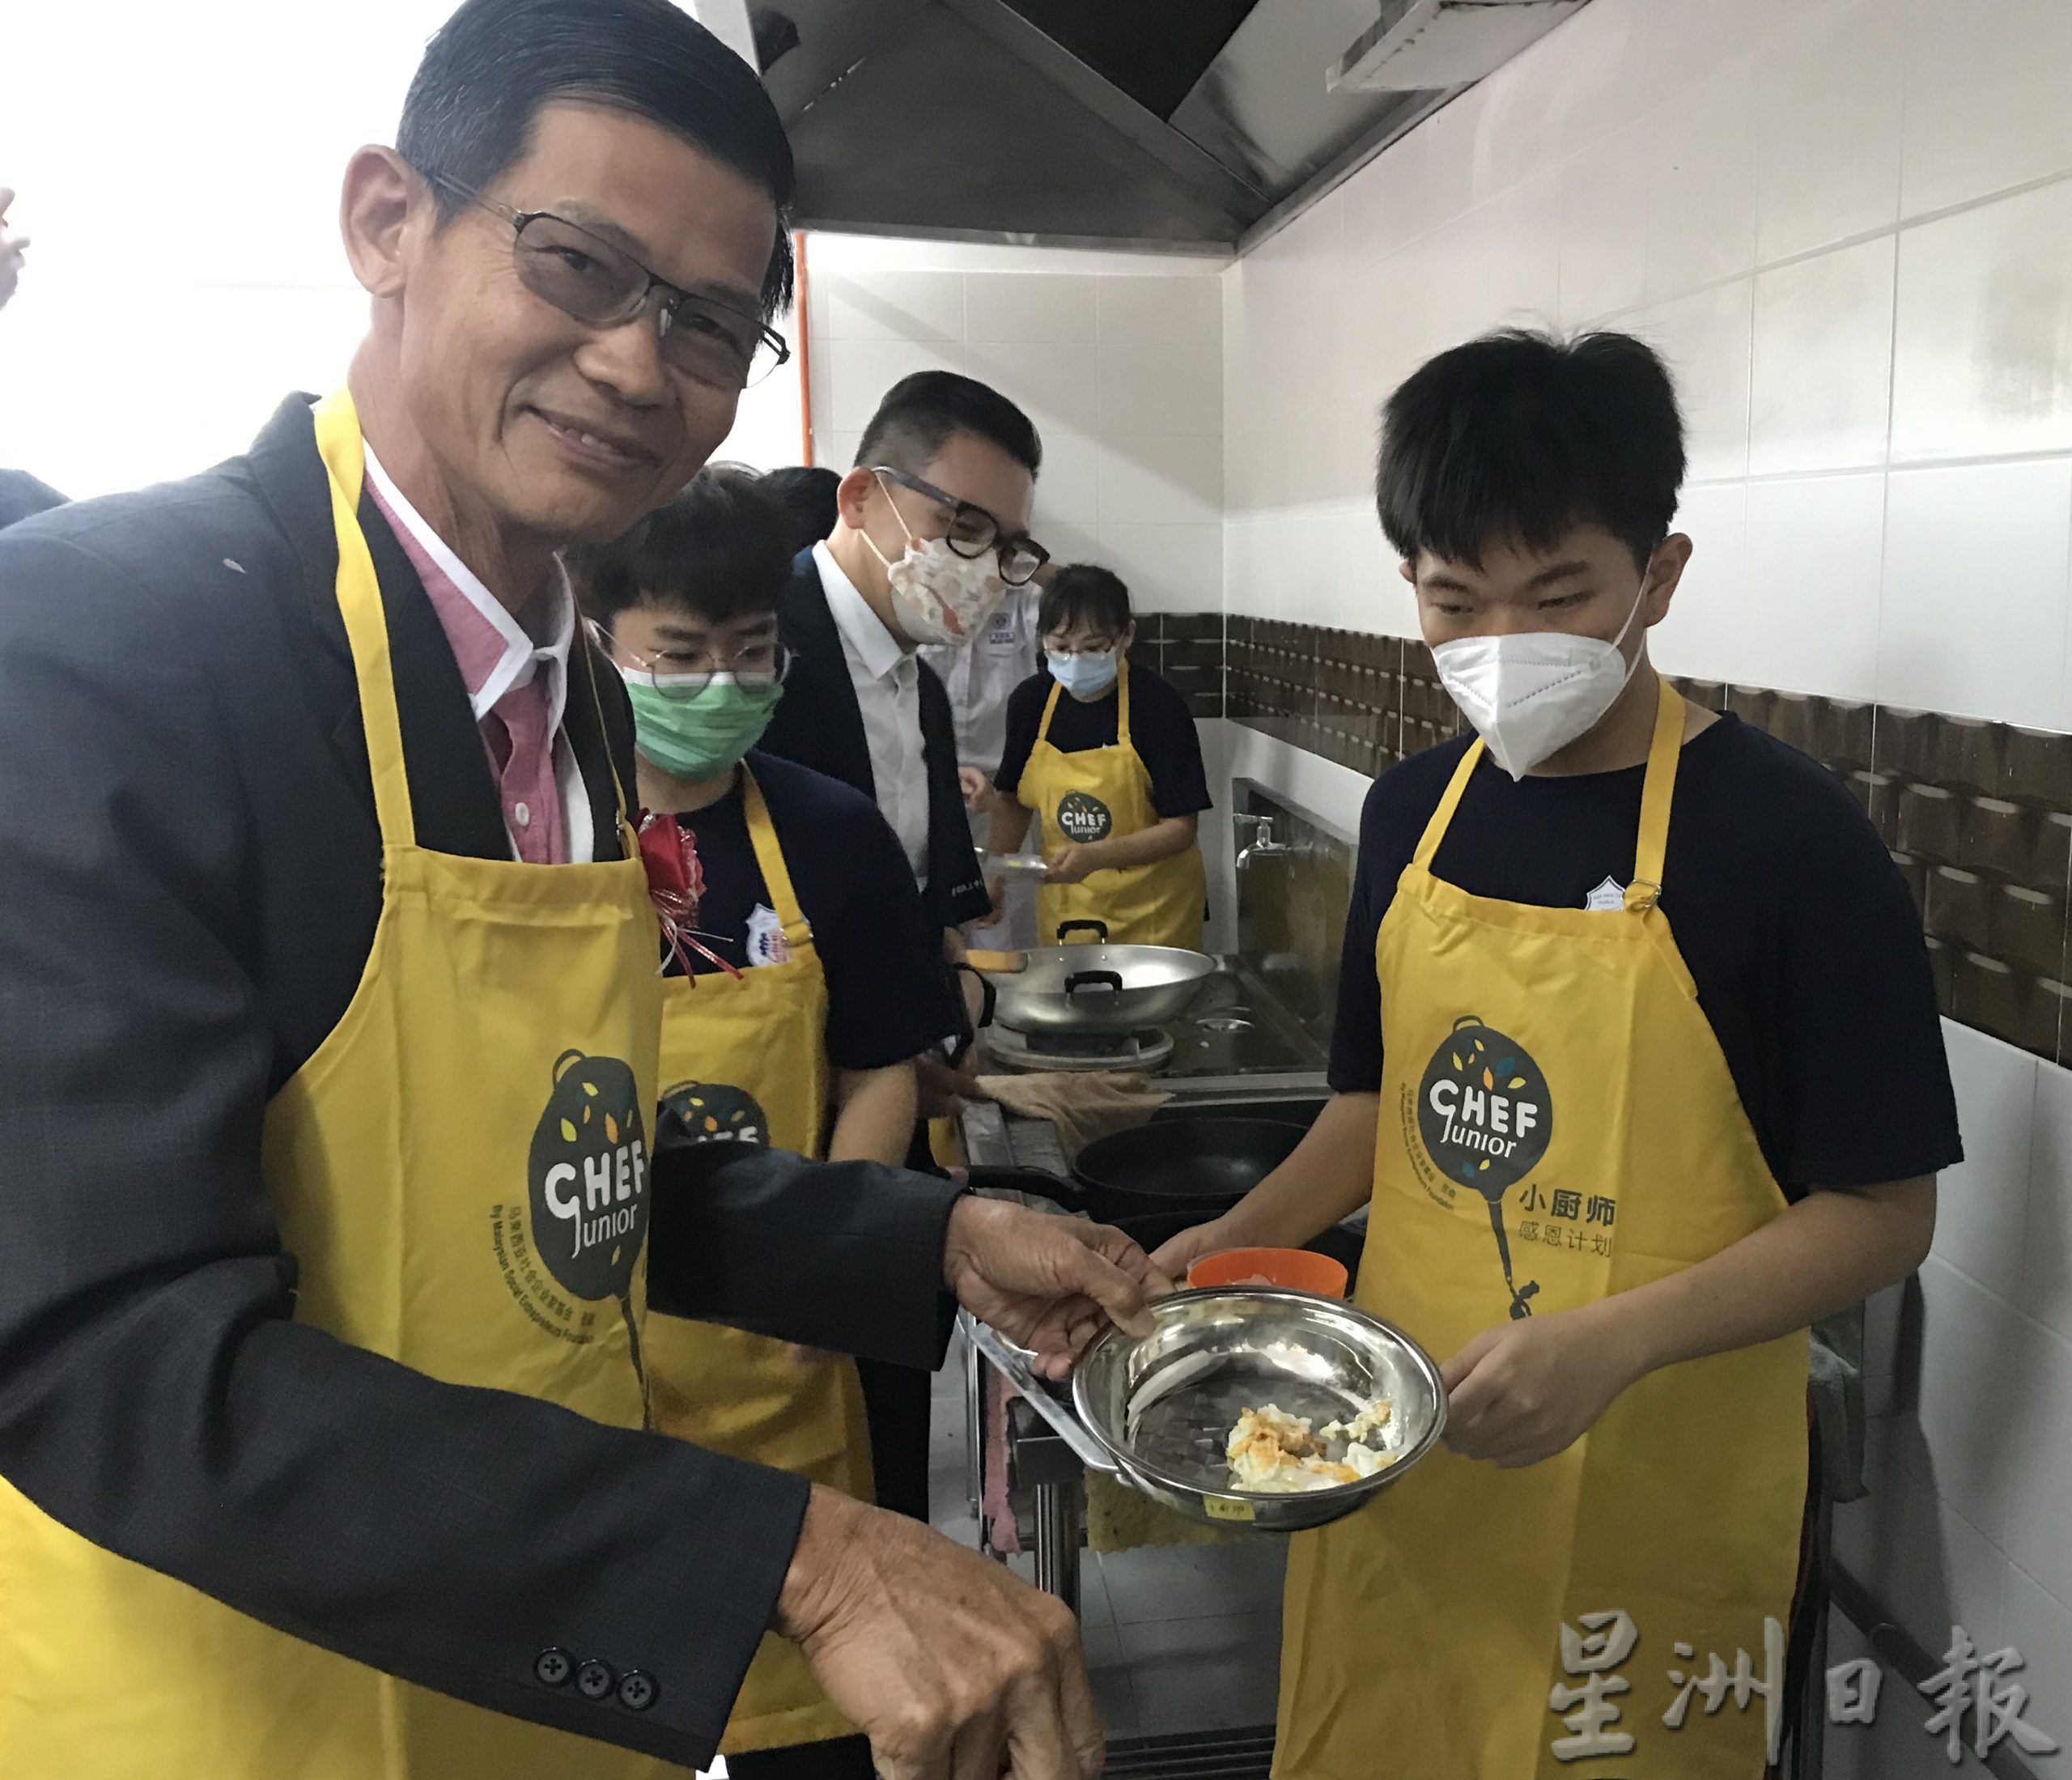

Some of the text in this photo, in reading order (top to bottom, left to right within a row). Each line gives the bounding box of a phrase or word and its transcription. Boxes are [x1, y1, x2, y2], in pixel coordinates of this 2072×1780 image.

[1061, 811, 1106, 826] CHEF
[1429, 1079, 1538, 1138] CHEF
[1440, 1115, 1517, 1158] Junior
[545, 1139, 645, 1220] CHEF
[1519, 1183, 1616, 1226] 小厨师
[571, 1204, 638, 1260] Junior
[1518, 1221, 1612, 1258] 感恩计划
